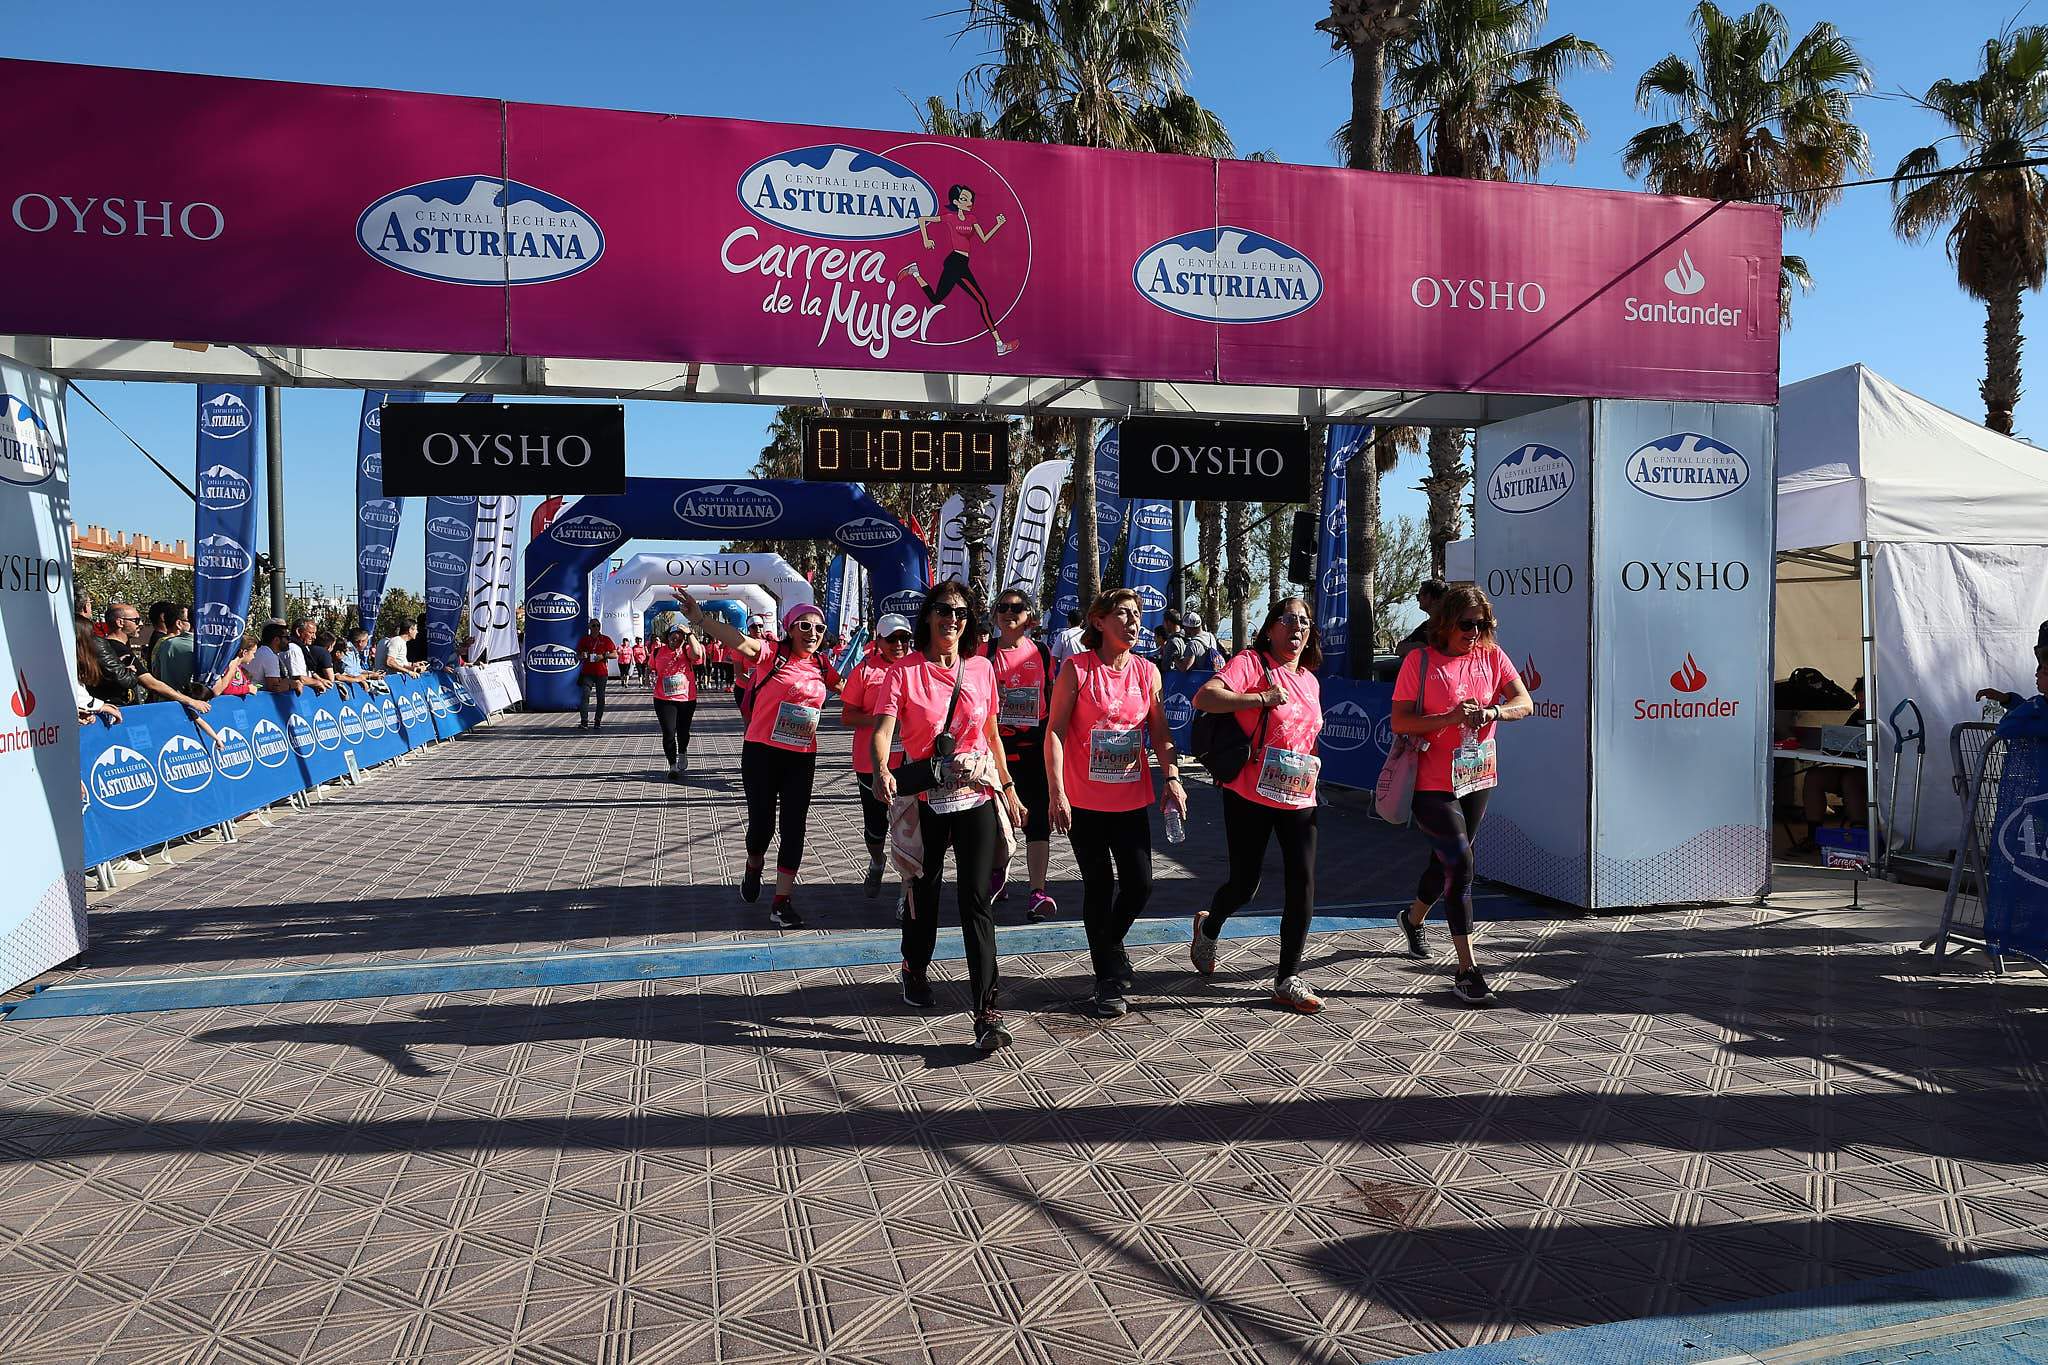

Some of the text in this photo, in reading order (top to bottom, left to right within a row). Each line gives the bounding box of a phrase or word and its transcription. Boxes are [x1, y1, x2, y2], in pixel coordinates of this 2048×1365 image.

[754, 173, 922, 220] ASTURIANA
[785, 173, 917, 192] CENTRAL LECHERA
[12, 192, 225, 242] OYSHO
[415, 210, 493, 225] CENTRAL
[377, 211, 586, 260] ASTURIANA
[720, 225, 886, 283] Carrera
[1178, 257, 1302, 273] CENTRAL LECHERA
[1148, 257, 1309, 301] ASTURIANA
[1411, 275, 1546, 314] OYSHO
[762, 280, 946, 359] de la Mujer
[1624, 297, 1742, 328] Santander
[0, 434, 52, 470] URIANA
[422, 432, 592, 467] OYSHO
[1151, 443, 1285, 477] OYSHO
[1654, 456, 1736, 465] CENTRAL LECHERA
[1504, 461, 1565, 478] CENTRAL LECHERA
[1635, 457, 1740, 485] ASTURIANA
[1493, 471, 1568, 501] ASTURIANA
[682, 498, 775, 518] ASTURIANA
[556, 526, 617, 540] ASTURIANA
[842, 529, 898, 541] ASTURIANA
[1007, 485, 1052, 588] YSHO
[0, 554, 61, 594] YSHO
[666, 559, 750, 577] OYSHO
[1487, 563, 1574, 598] OYSHO
[1621, 560, 1749, 592] OYSHO
[529, 602, 576, 614] ASTURIANA
[529, 654, 576, 666] ASTURIANA
[1634, 697, 1740, 720] Santander
[0, 722, 60, 754] antander
[97, 770, 155, 799] ASTURIANA
[164, 757, 211, 783] ASTURIANA
